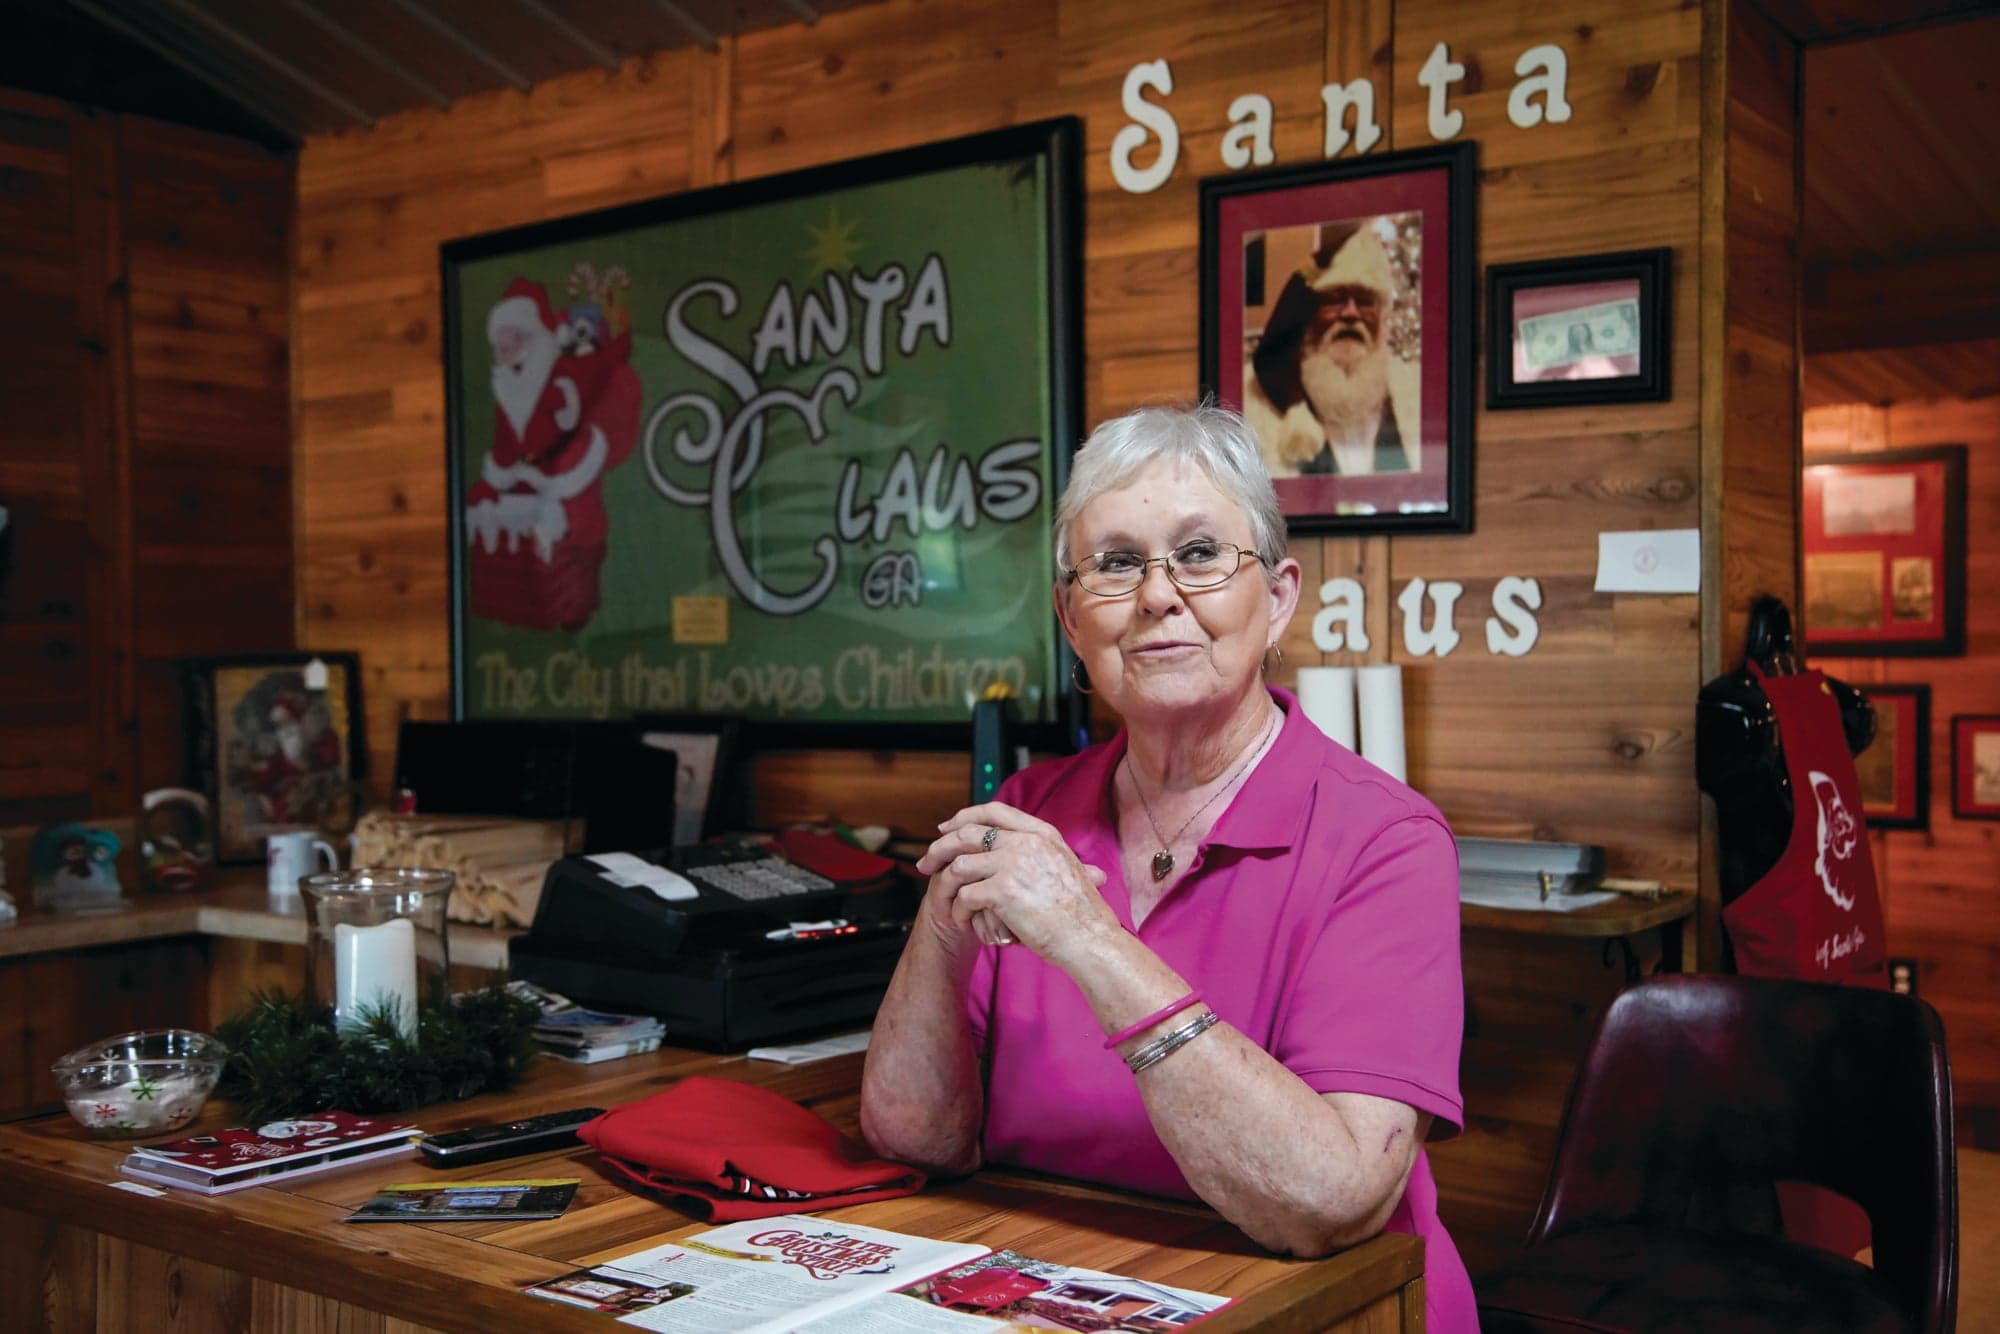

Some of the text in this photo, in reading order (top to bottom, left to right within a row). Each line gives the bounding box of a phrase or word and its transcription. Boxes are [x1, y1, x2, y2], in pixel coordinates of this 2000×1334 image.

[1110, 42, 1572, 194] Santa
[1311, 575, 1543, 657] aus
[476, 642, 1026, 719] The City that Loves Children
